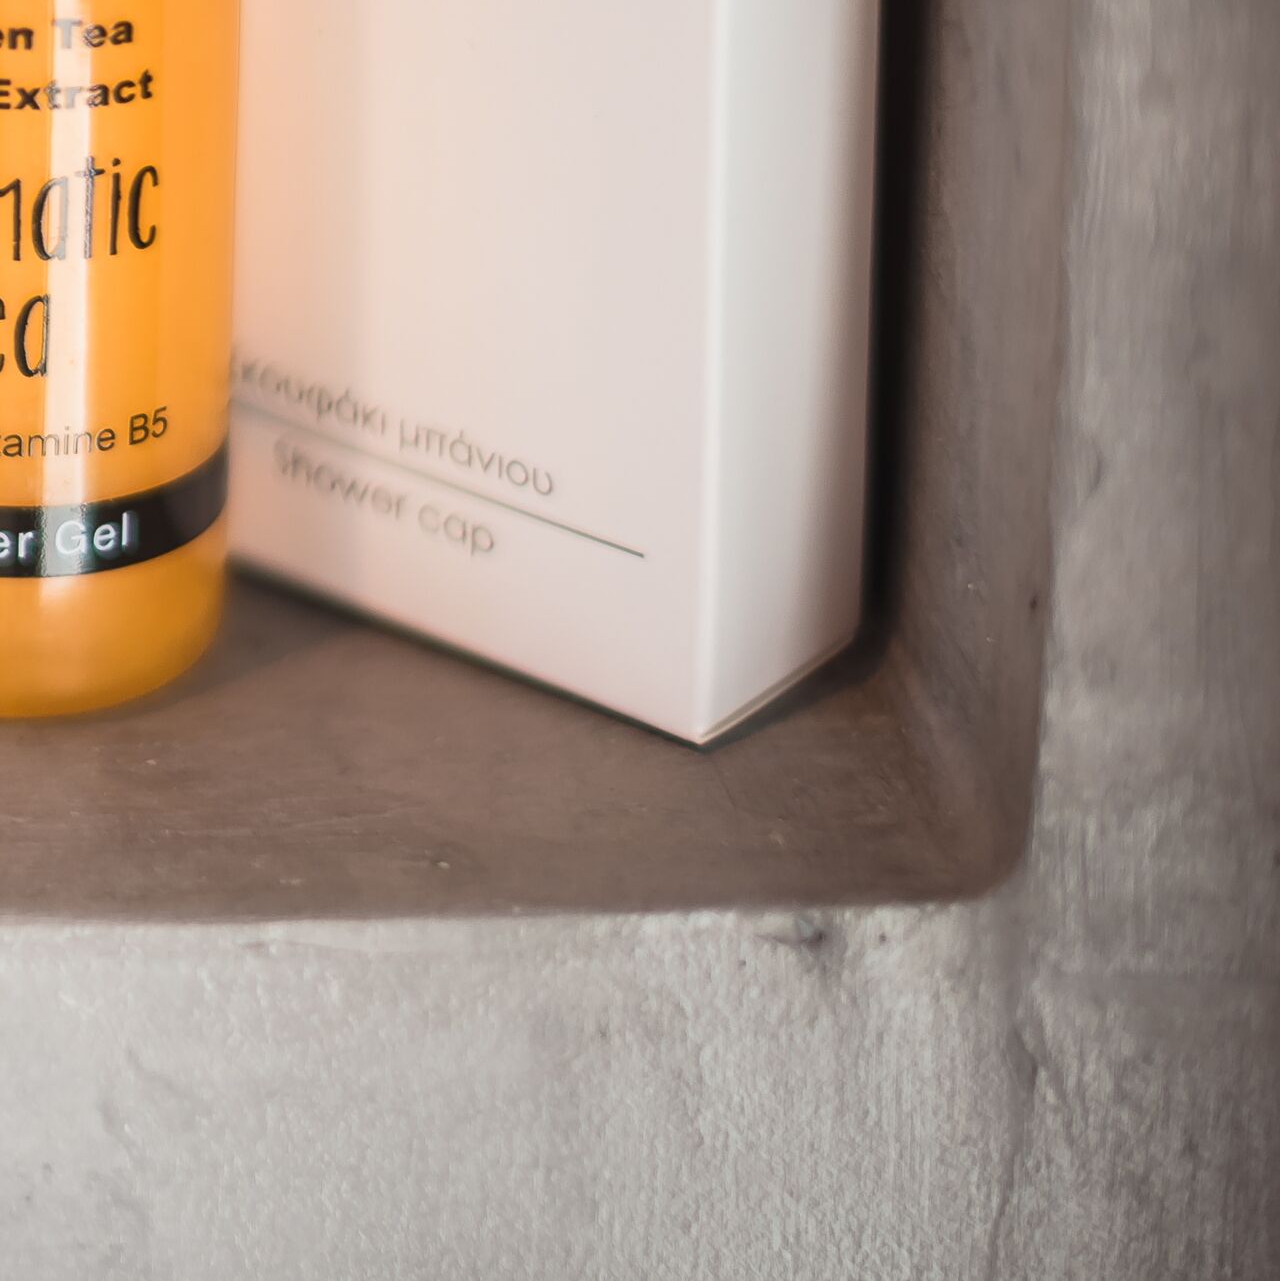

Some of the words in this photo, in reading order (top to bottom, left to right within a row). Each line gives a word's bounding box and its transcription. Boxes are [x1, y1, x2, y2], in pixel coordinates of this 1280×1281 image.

[55, 18, 134, 49] Tea
[129, 406, 168, 445] B5
[231, 360, 386, 436] κουφάκι
[398, 417, 555, 497] μπάνιου
[56, 511, 130, 556] Gel
[417, 503, 495, 558] cap
